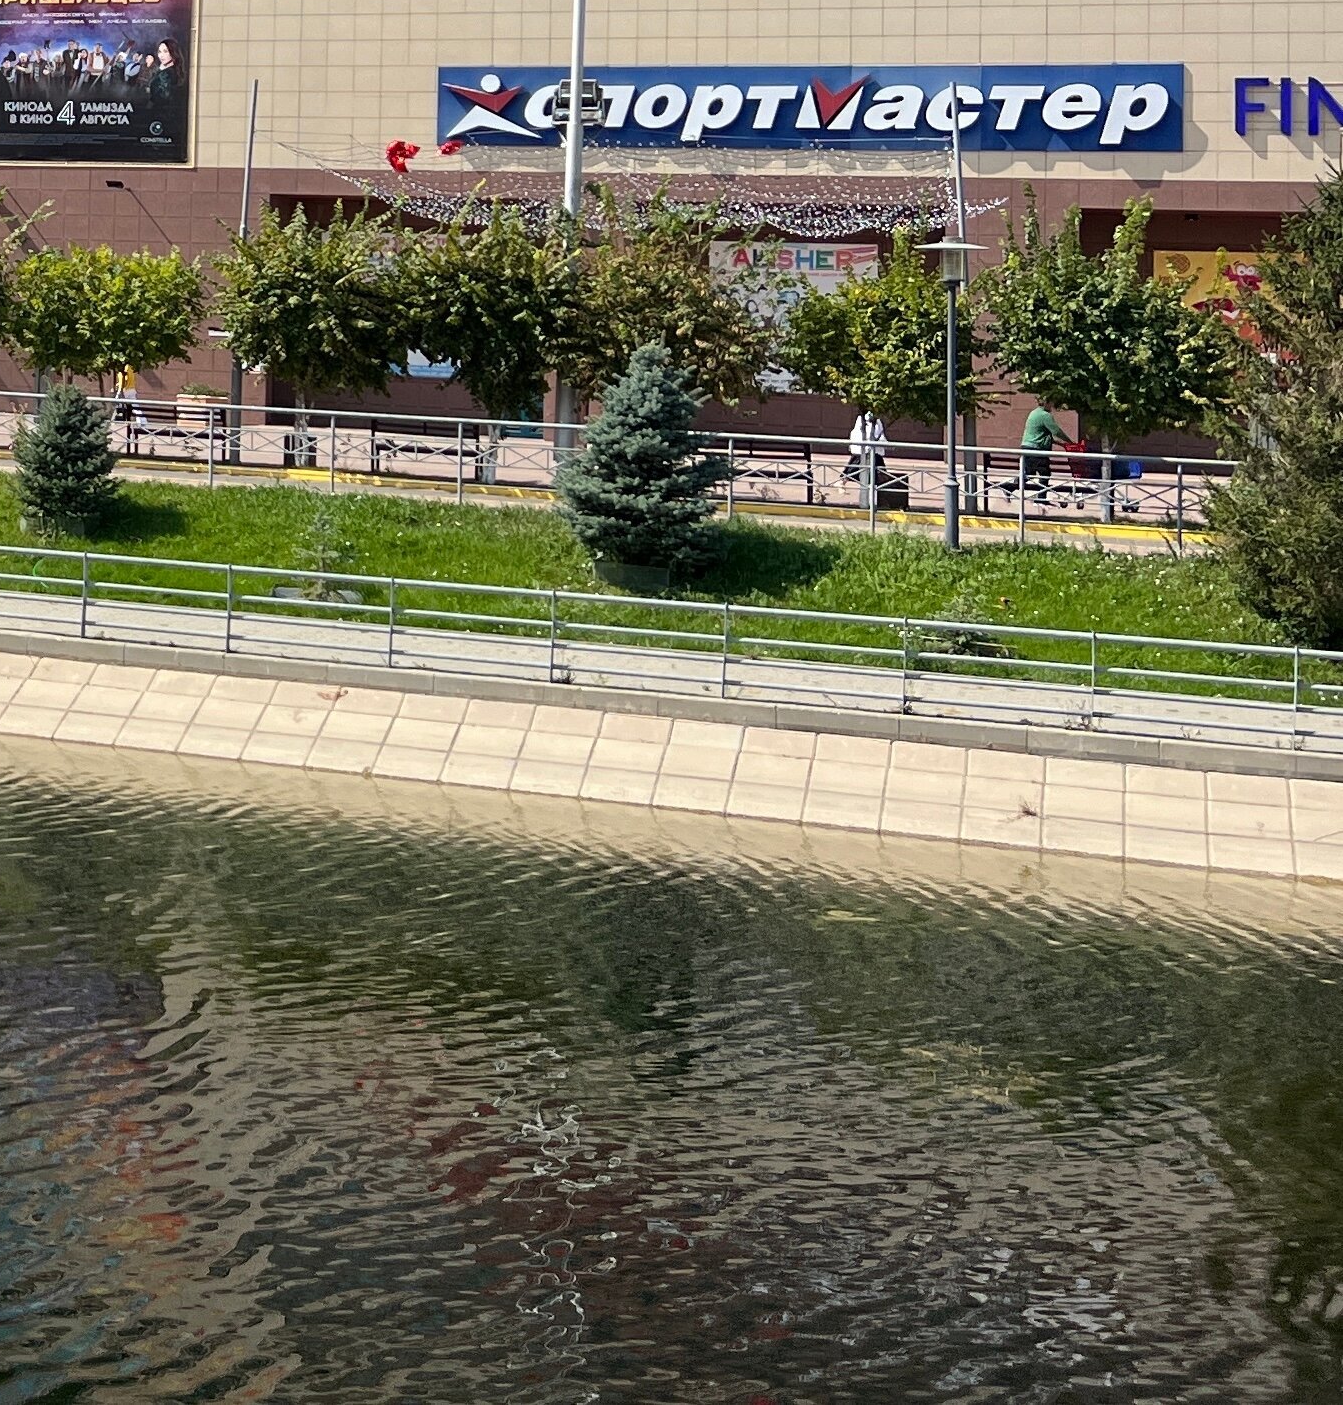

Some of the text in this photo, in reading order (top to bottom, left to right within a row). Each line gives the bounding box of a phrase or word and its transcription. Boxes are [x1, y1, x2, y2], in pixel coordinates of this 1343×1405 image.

[4, 101, 53, 112] КИНОДА
[80, 102, 134, 113] ТАМЫЗДА
[57, 100, 75, 126] 4
[19, 114, 53, 124] КИНО
[80, 114, 130, 125] АВГУСТА
